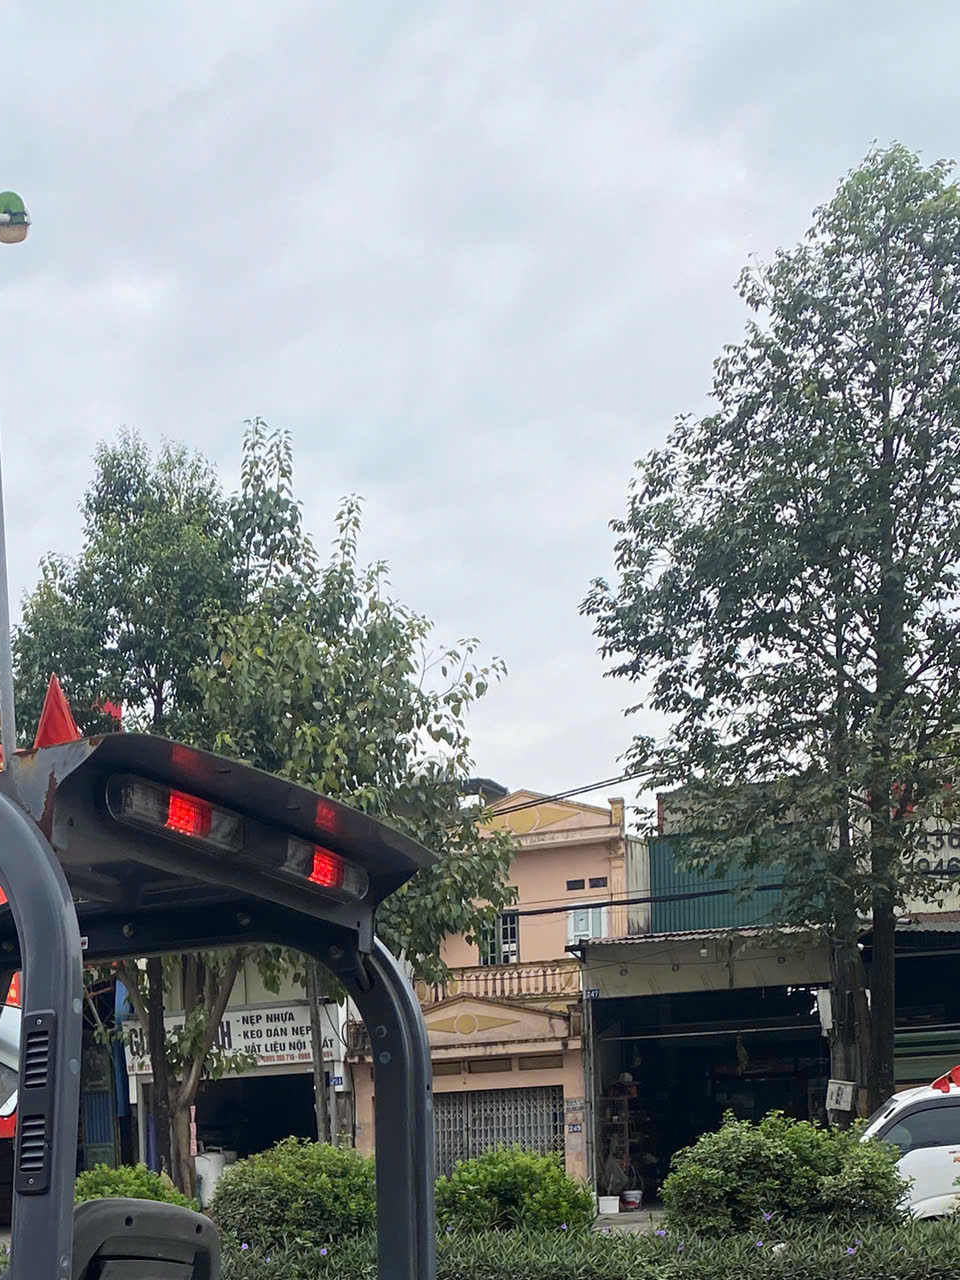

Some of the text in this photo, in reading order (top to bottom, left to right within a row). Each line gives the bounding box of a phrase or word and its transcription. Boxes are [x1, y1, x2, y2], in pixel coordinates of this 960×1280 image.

[586, 989, 600, 998] 247
[241, 1011, 295, 1026] NẸP NHỰA
[242, 1026, 312, 1040] KEO DÁN NẸP
[264, 1041, 286, 1054] LIỆU
[288, 1039, 306, 1053] NỘI
